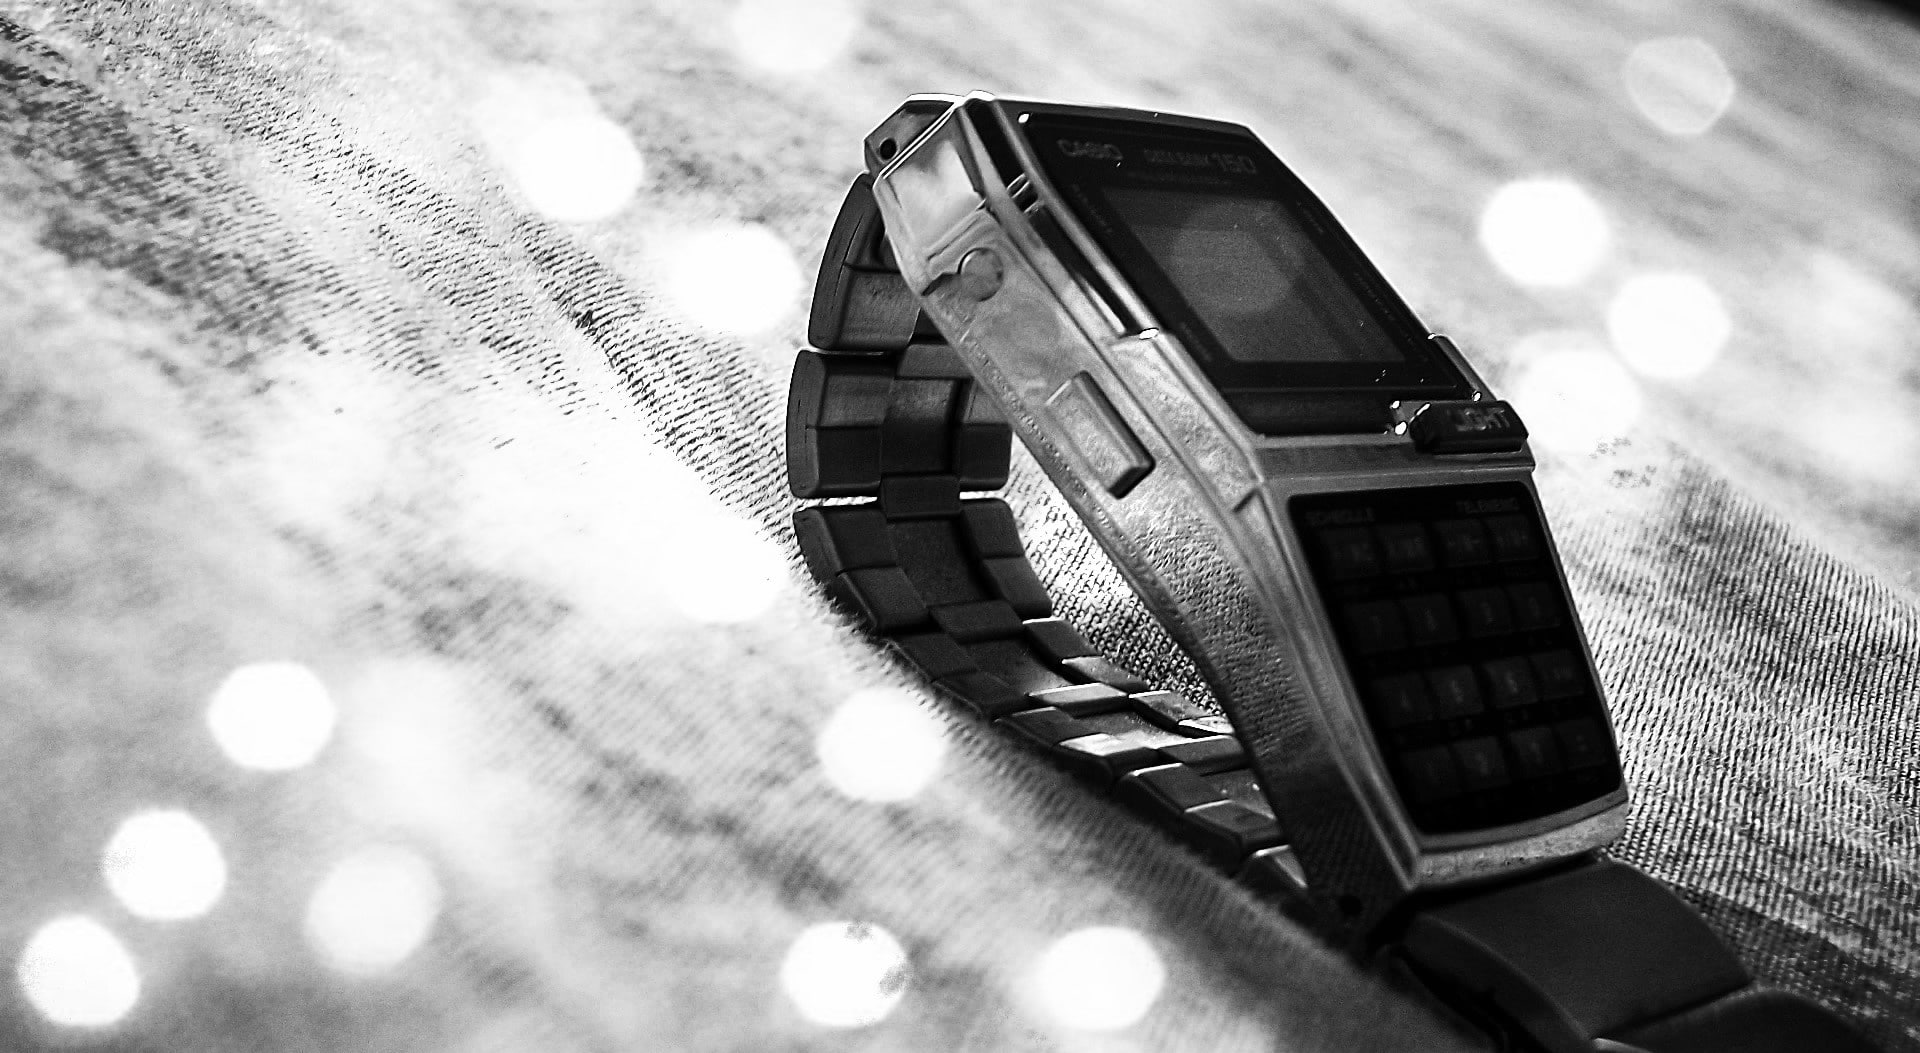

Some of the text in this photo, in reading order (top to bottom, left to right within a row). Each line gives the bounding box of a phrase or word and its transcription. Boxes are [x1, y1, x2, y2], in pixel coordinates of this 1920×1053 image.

[1055, 138, 1124, 161] CASIO
[1209, 151, 1259, 175] 150
[1446, 406, 1511, 432] LIGHT
